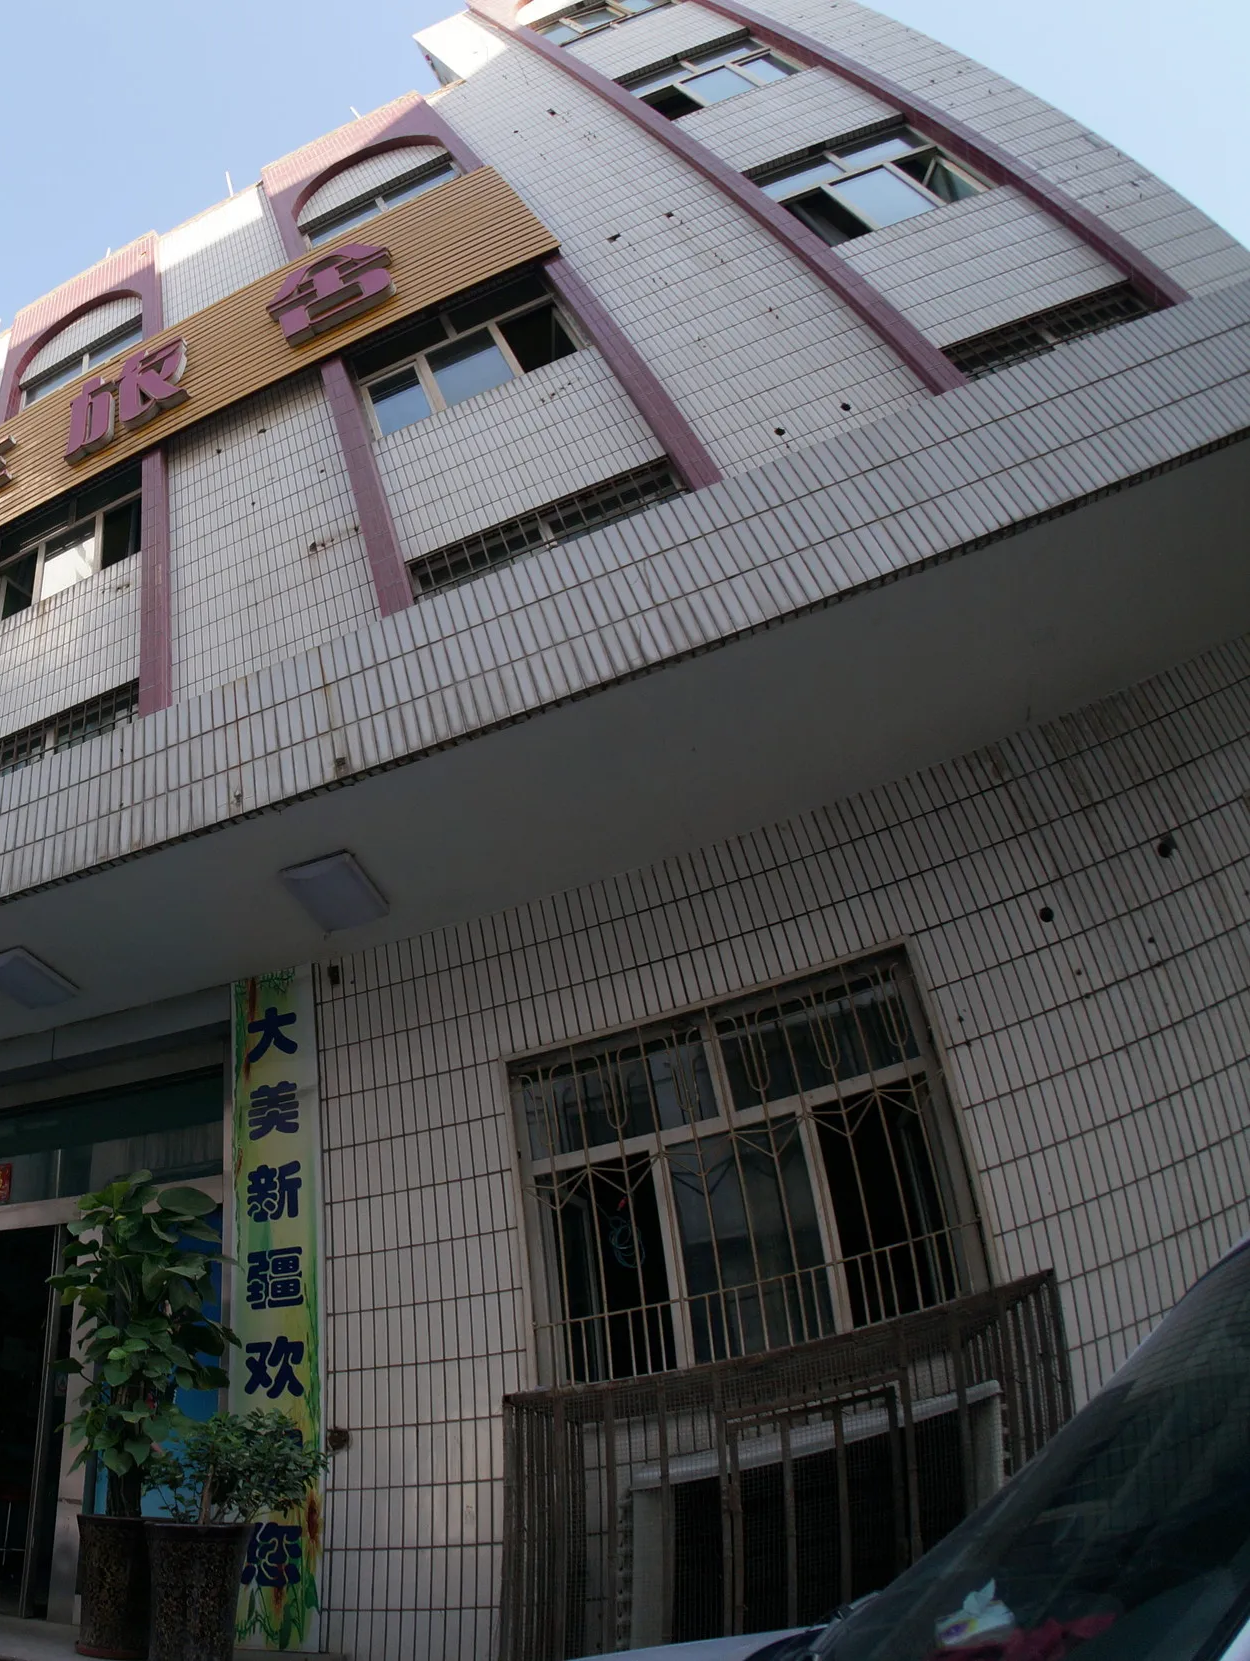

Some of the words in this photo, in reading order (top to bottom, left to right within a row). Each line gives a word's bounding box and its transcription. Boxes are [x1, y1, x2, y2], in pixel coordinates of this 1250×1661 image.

[240, 1006, 305, 1587] 大美新疆欢您
